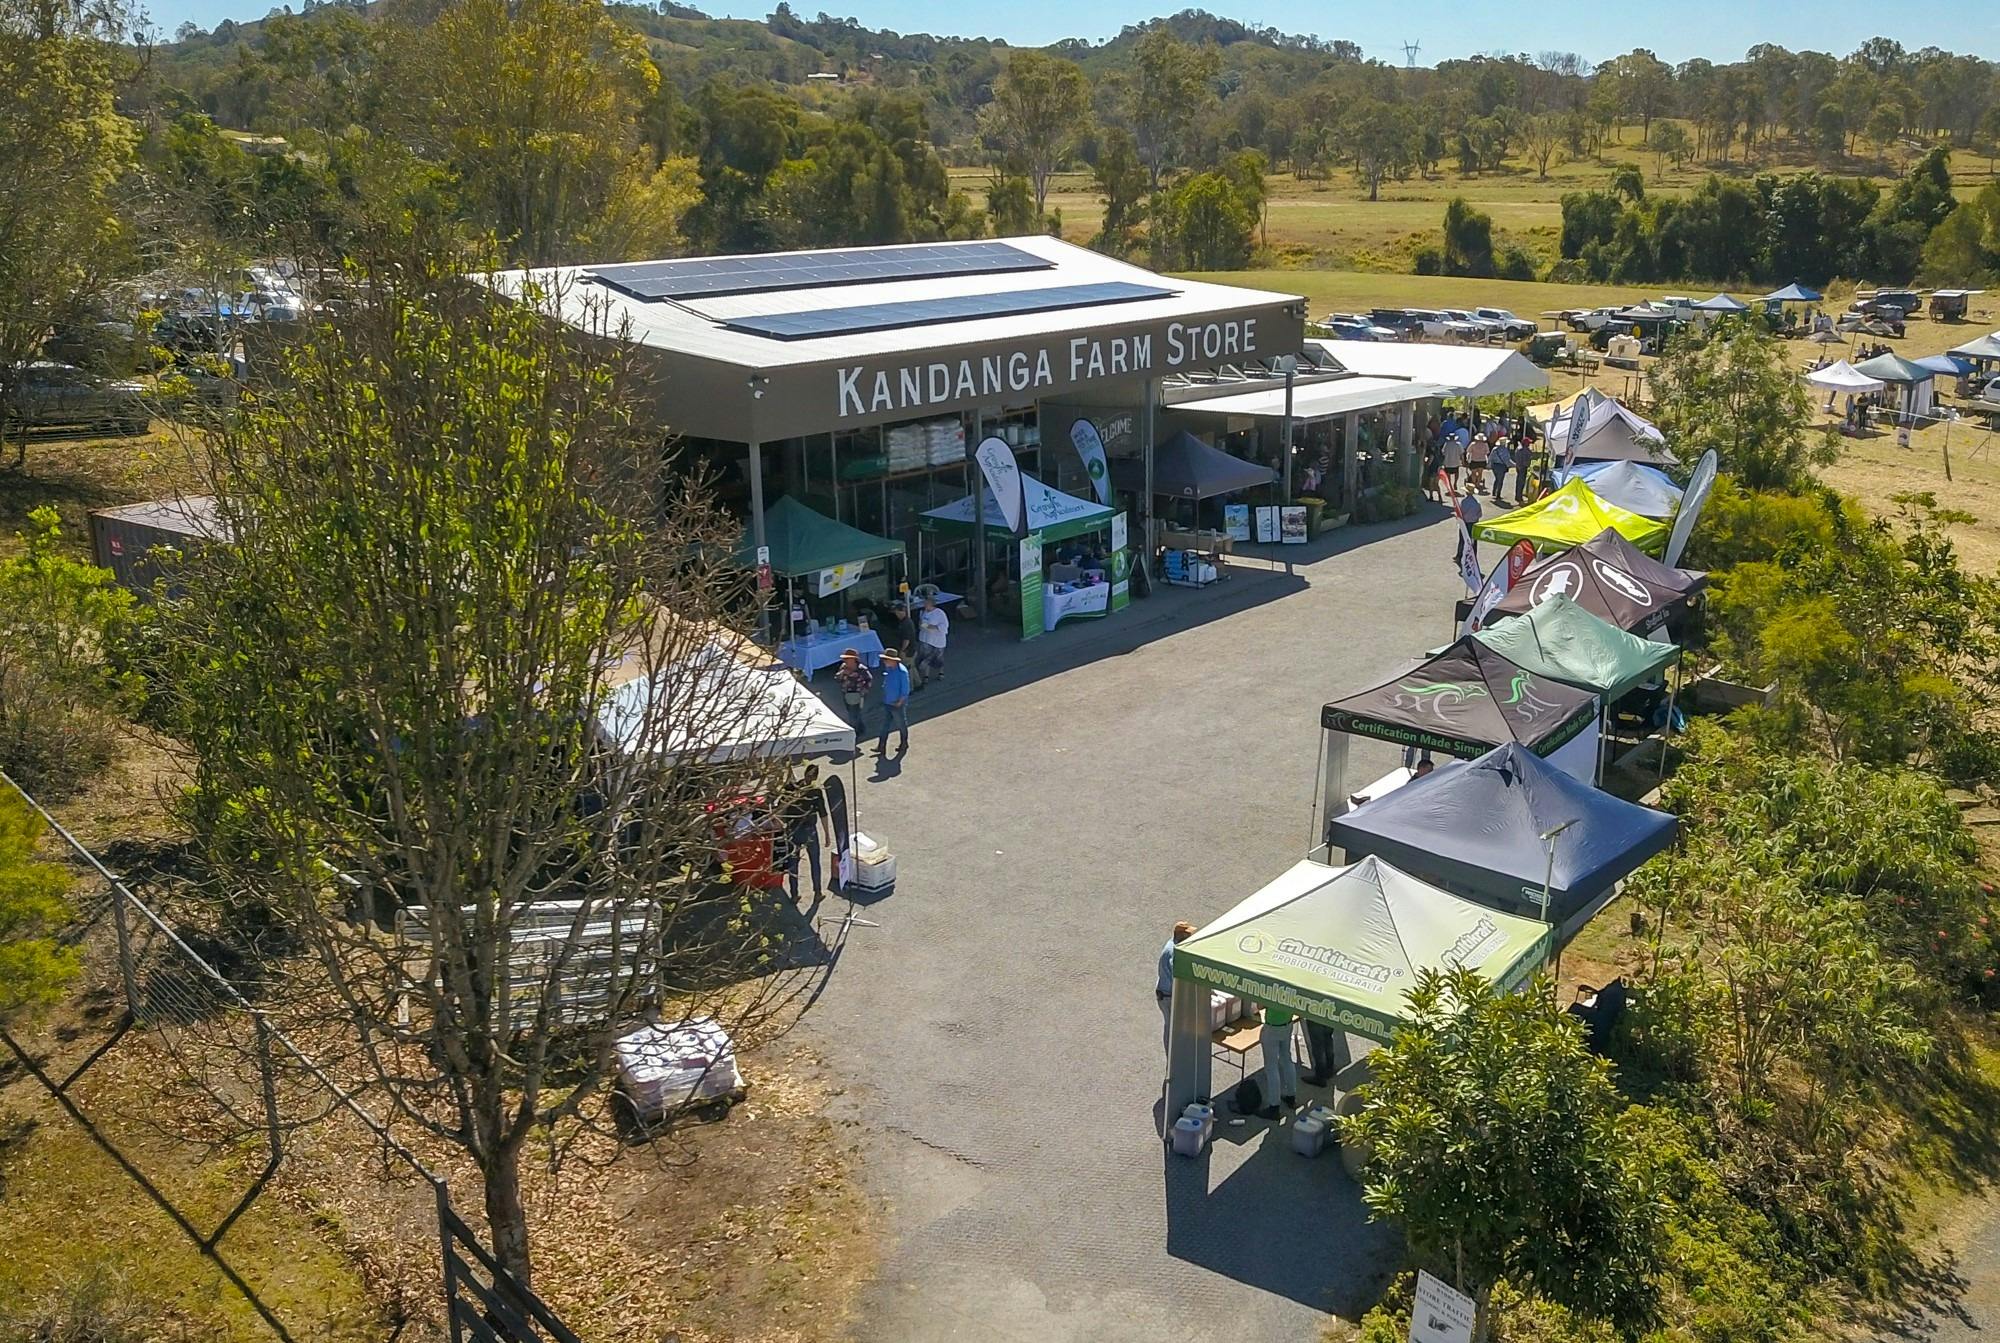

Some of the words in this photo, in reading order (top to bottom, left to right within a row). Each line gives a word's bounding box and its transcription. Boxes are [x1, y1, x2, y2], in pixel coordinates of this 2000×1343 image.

[837, 348, 1054, 418] KANDANGA
[1069, 334, 1152, 382] FARM
[1166, 318, 1257, 366] STORE
[1351, 719, 1417, 743] Certification
[1420, 734, 1452, 750] Made
[1454, 741, 1488, 757] Simpl
[1272, 953, 1330, 977] PROBIOTICS
[1330, 970, 1384, 994] AUSTRALIA
